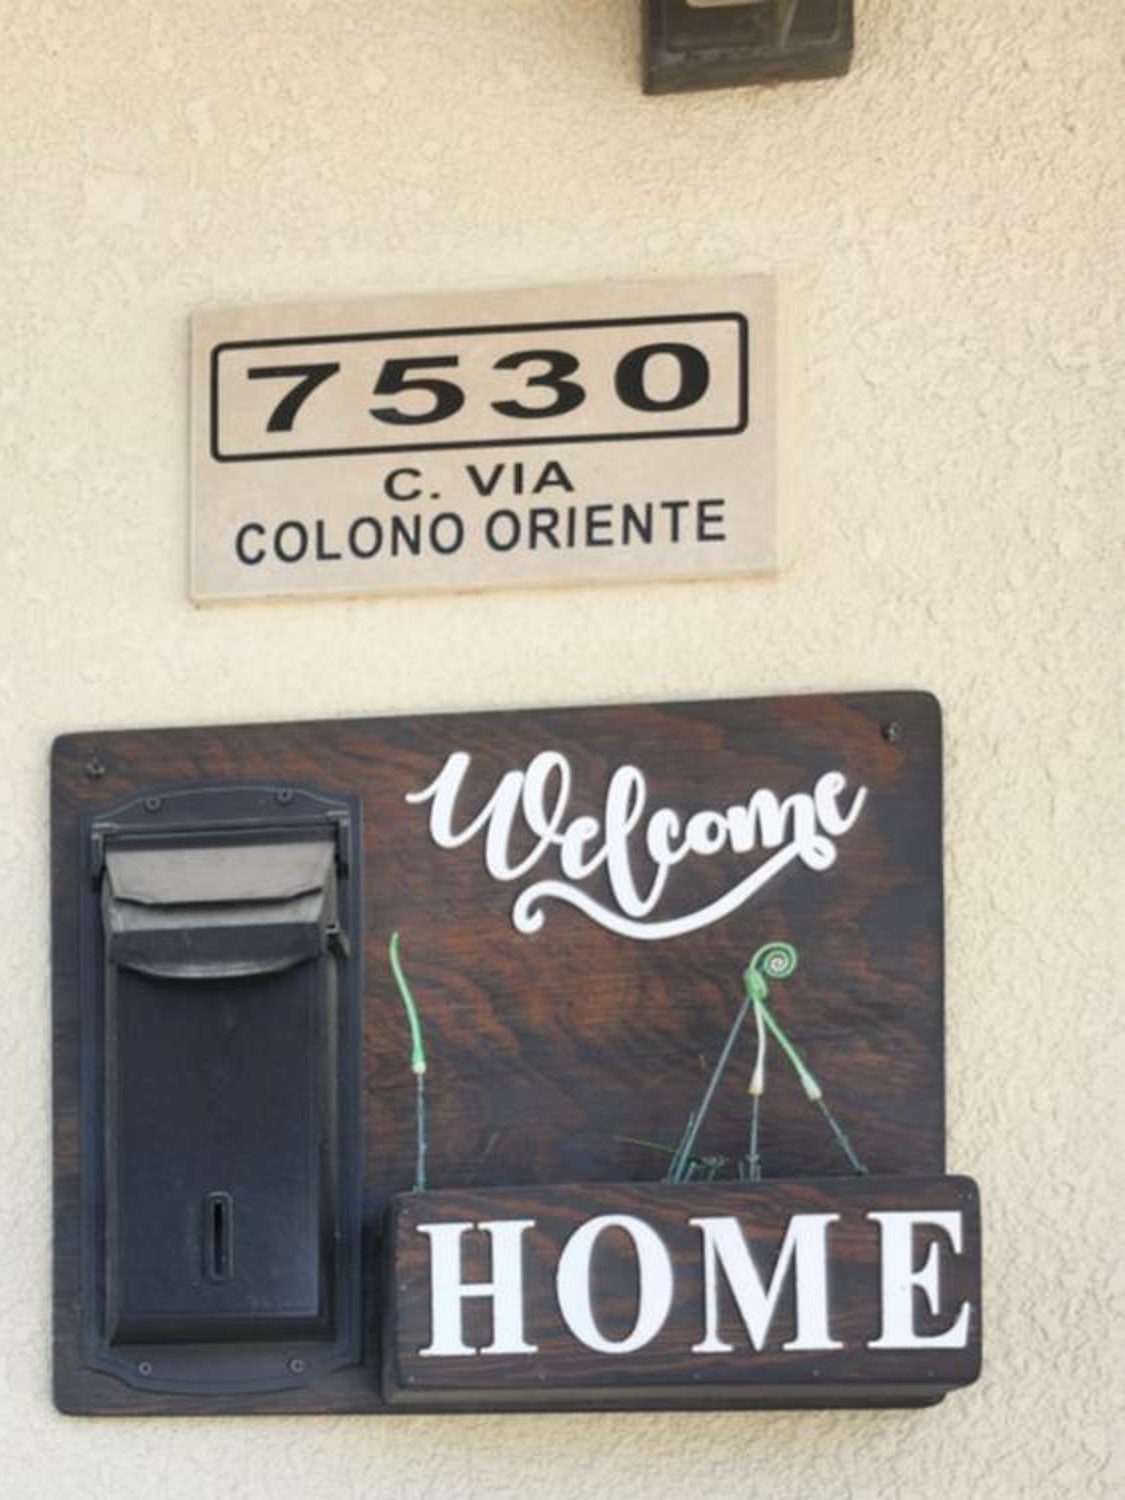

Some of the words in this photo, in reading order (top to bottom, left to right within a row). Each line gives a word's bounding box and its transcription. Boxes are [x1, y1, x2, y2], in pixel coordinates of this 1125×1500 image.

[246, 341, 711, 434] 7530
[382, 466, 442, 501] C.
[465, 460, 575, 498] VIA
[234, 511, 465, 566] COLONO
[484, 498, 727, 552] ORIENTE
[405, 750, 868, 940] Welcome
[415, 1210, 972, 1358] HOME
